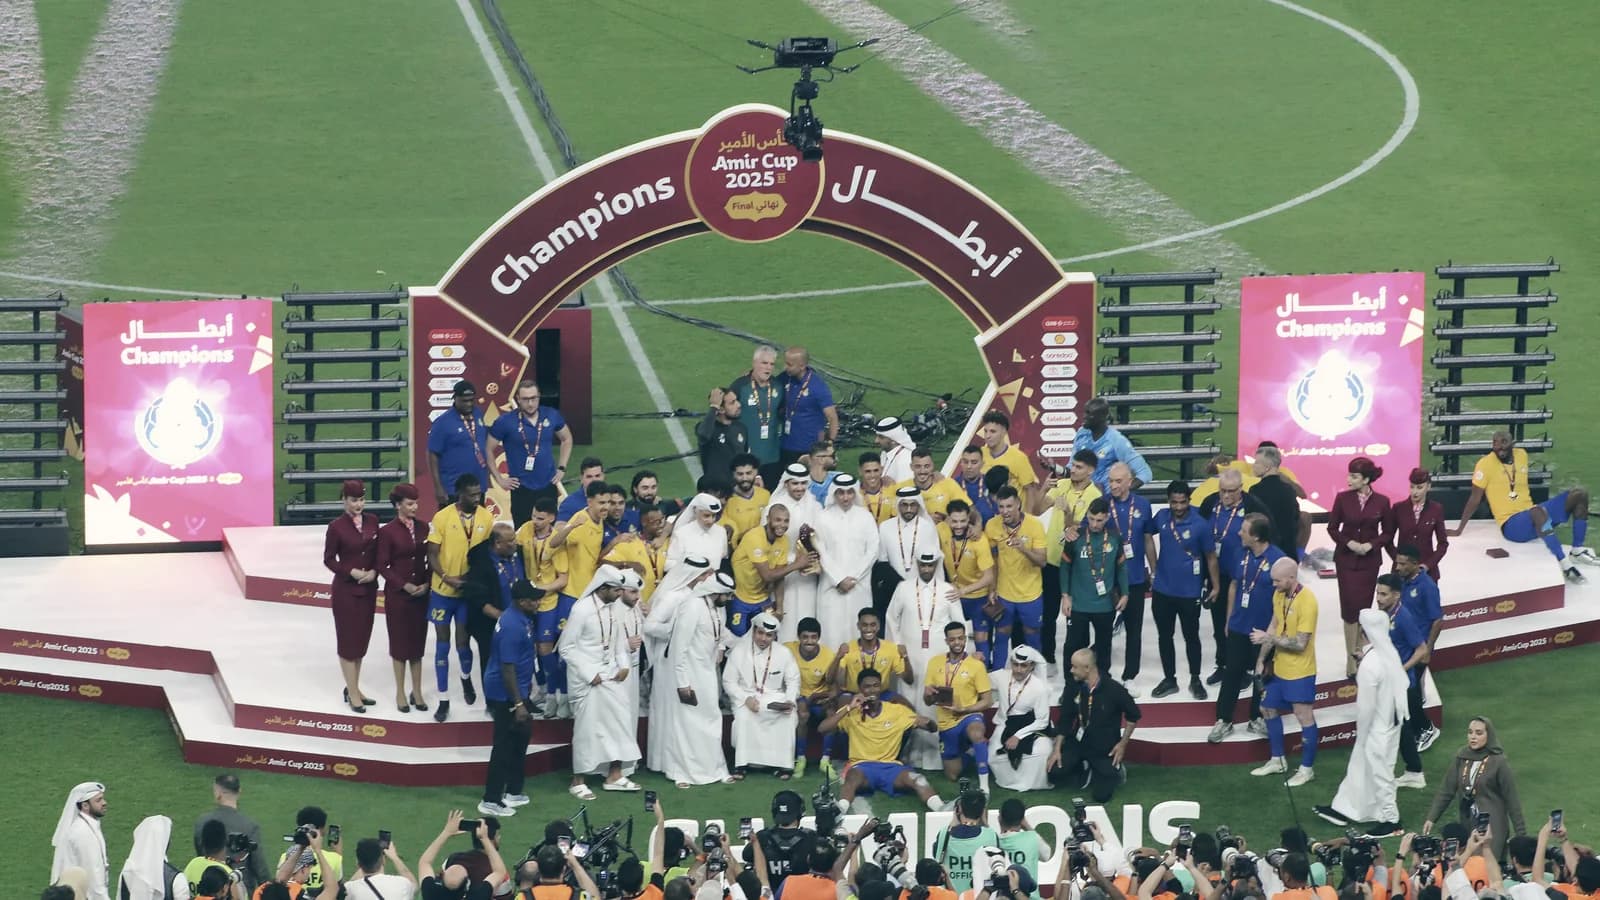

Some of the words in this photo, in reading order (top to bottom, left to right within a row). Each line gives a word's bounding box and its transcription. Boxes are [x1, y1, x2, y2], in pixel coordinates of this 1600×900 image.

[718, 131, 756, 152] الأمير
[757, 129, 788, 150] أس
[712, 153, 759, 171] Amir
[762, 153, 798, 171] Cup
[725, 171, 775, 188] 2025
[490, 176, 676, 296] Champions
[1276, 316, 1387, 341] Champions
[120, 345, 234, 369] Champions
[1471, 606, 1489, 616] 2025
[43, 642, 62, 651] Amir
[62, 644, 78, 654] Cup
[78, 645, 98, 655] 2025
[1529, 637, 1547, 647] 2025
[17, 679, 37, 688] Amir
[1315, 691, 1329, 700] 025
[296, 719, 315, 728] Amir
[316, 721, 332, 731] Cup
[332, 722, 353, 732] 2025
[267, 757, 287, 767] Amir
[287, 759, 304, 769] Cup
[303, 761, 325, 771] 2025
